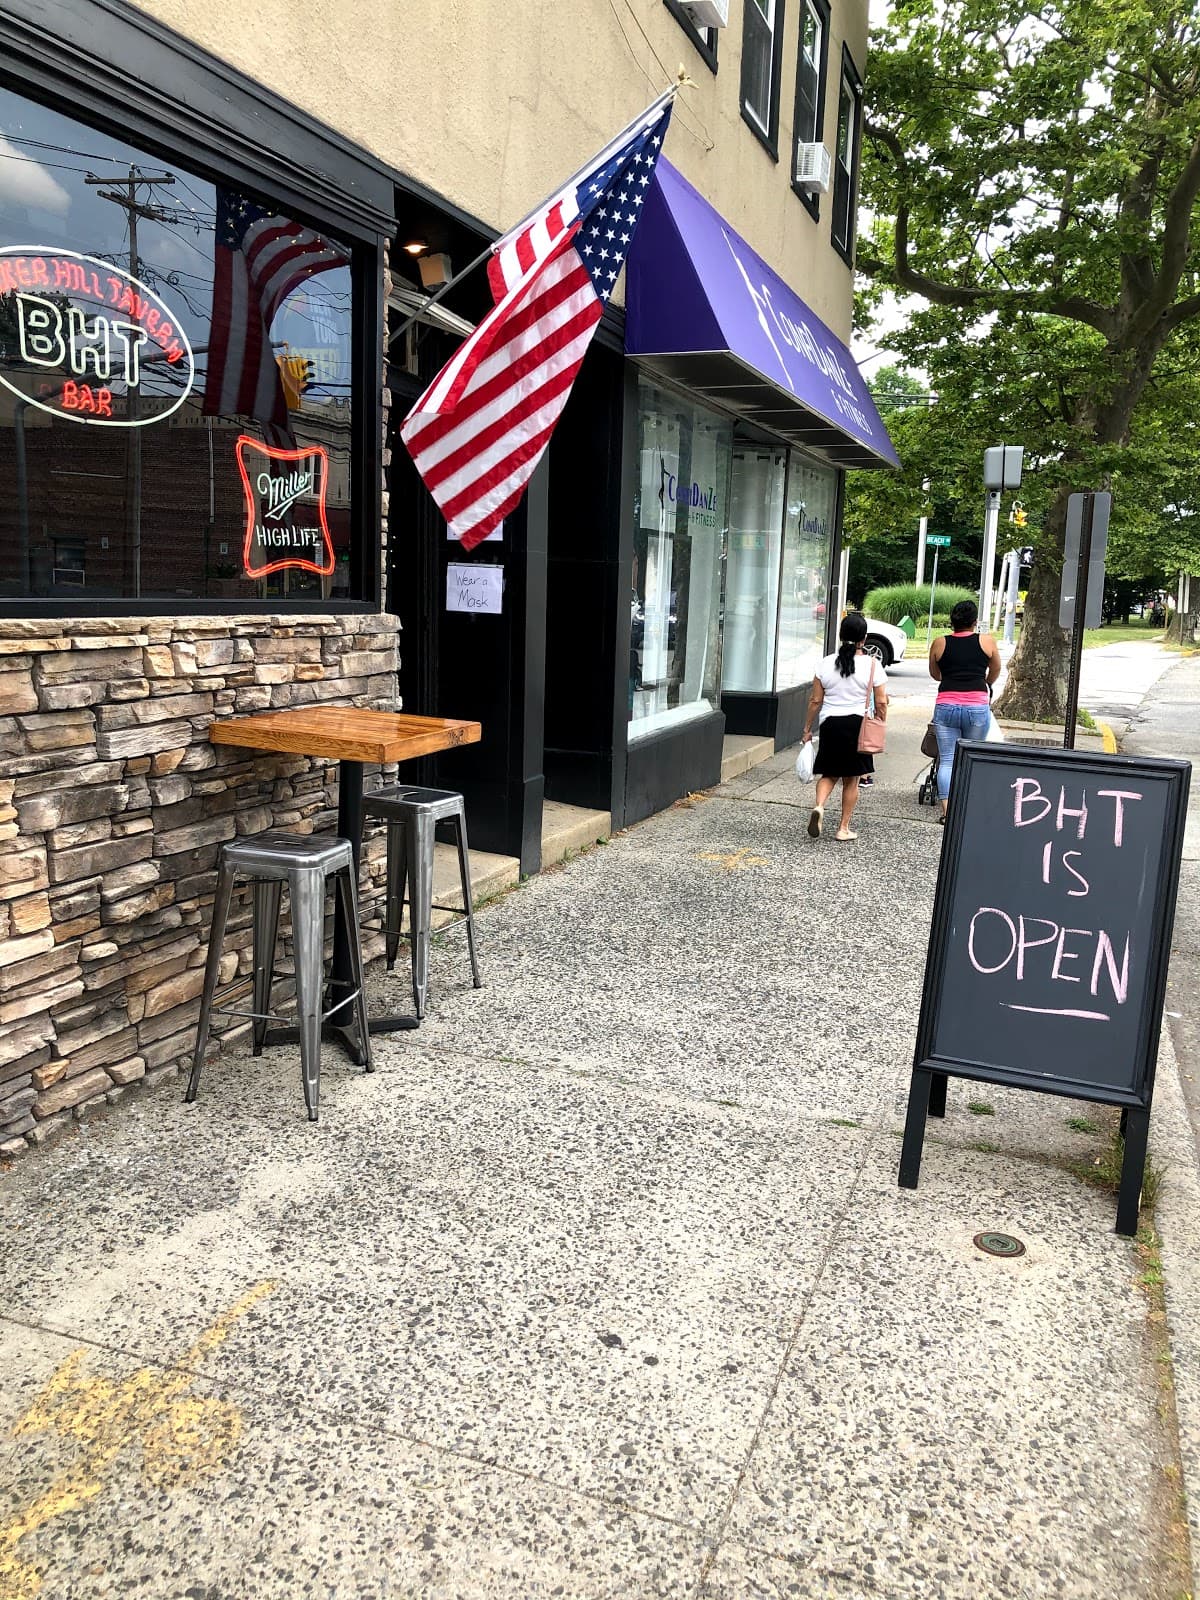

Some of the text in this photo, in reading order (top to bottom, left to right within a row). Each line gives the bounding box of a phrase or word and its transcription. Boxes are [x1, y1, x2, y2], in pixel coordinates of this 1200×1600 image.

[51, 259, 104, 300] HILL
[106, 276, 184, 364] TAVERN
[16, 292, 148, 387] BHT
[61, 379, 113, 417] BAR
[256, 470, 312, 511] Miller
[255, 524, 321, 547] HIGH LIFE
[455, 569, 481, 586] Wear
[457, 588, 489, 608] Mask
[1010, 777, 1144, 848] BHT
[1042, 840, 1090, 897] IS
[968, 906, 1131, 1005] OPEN
